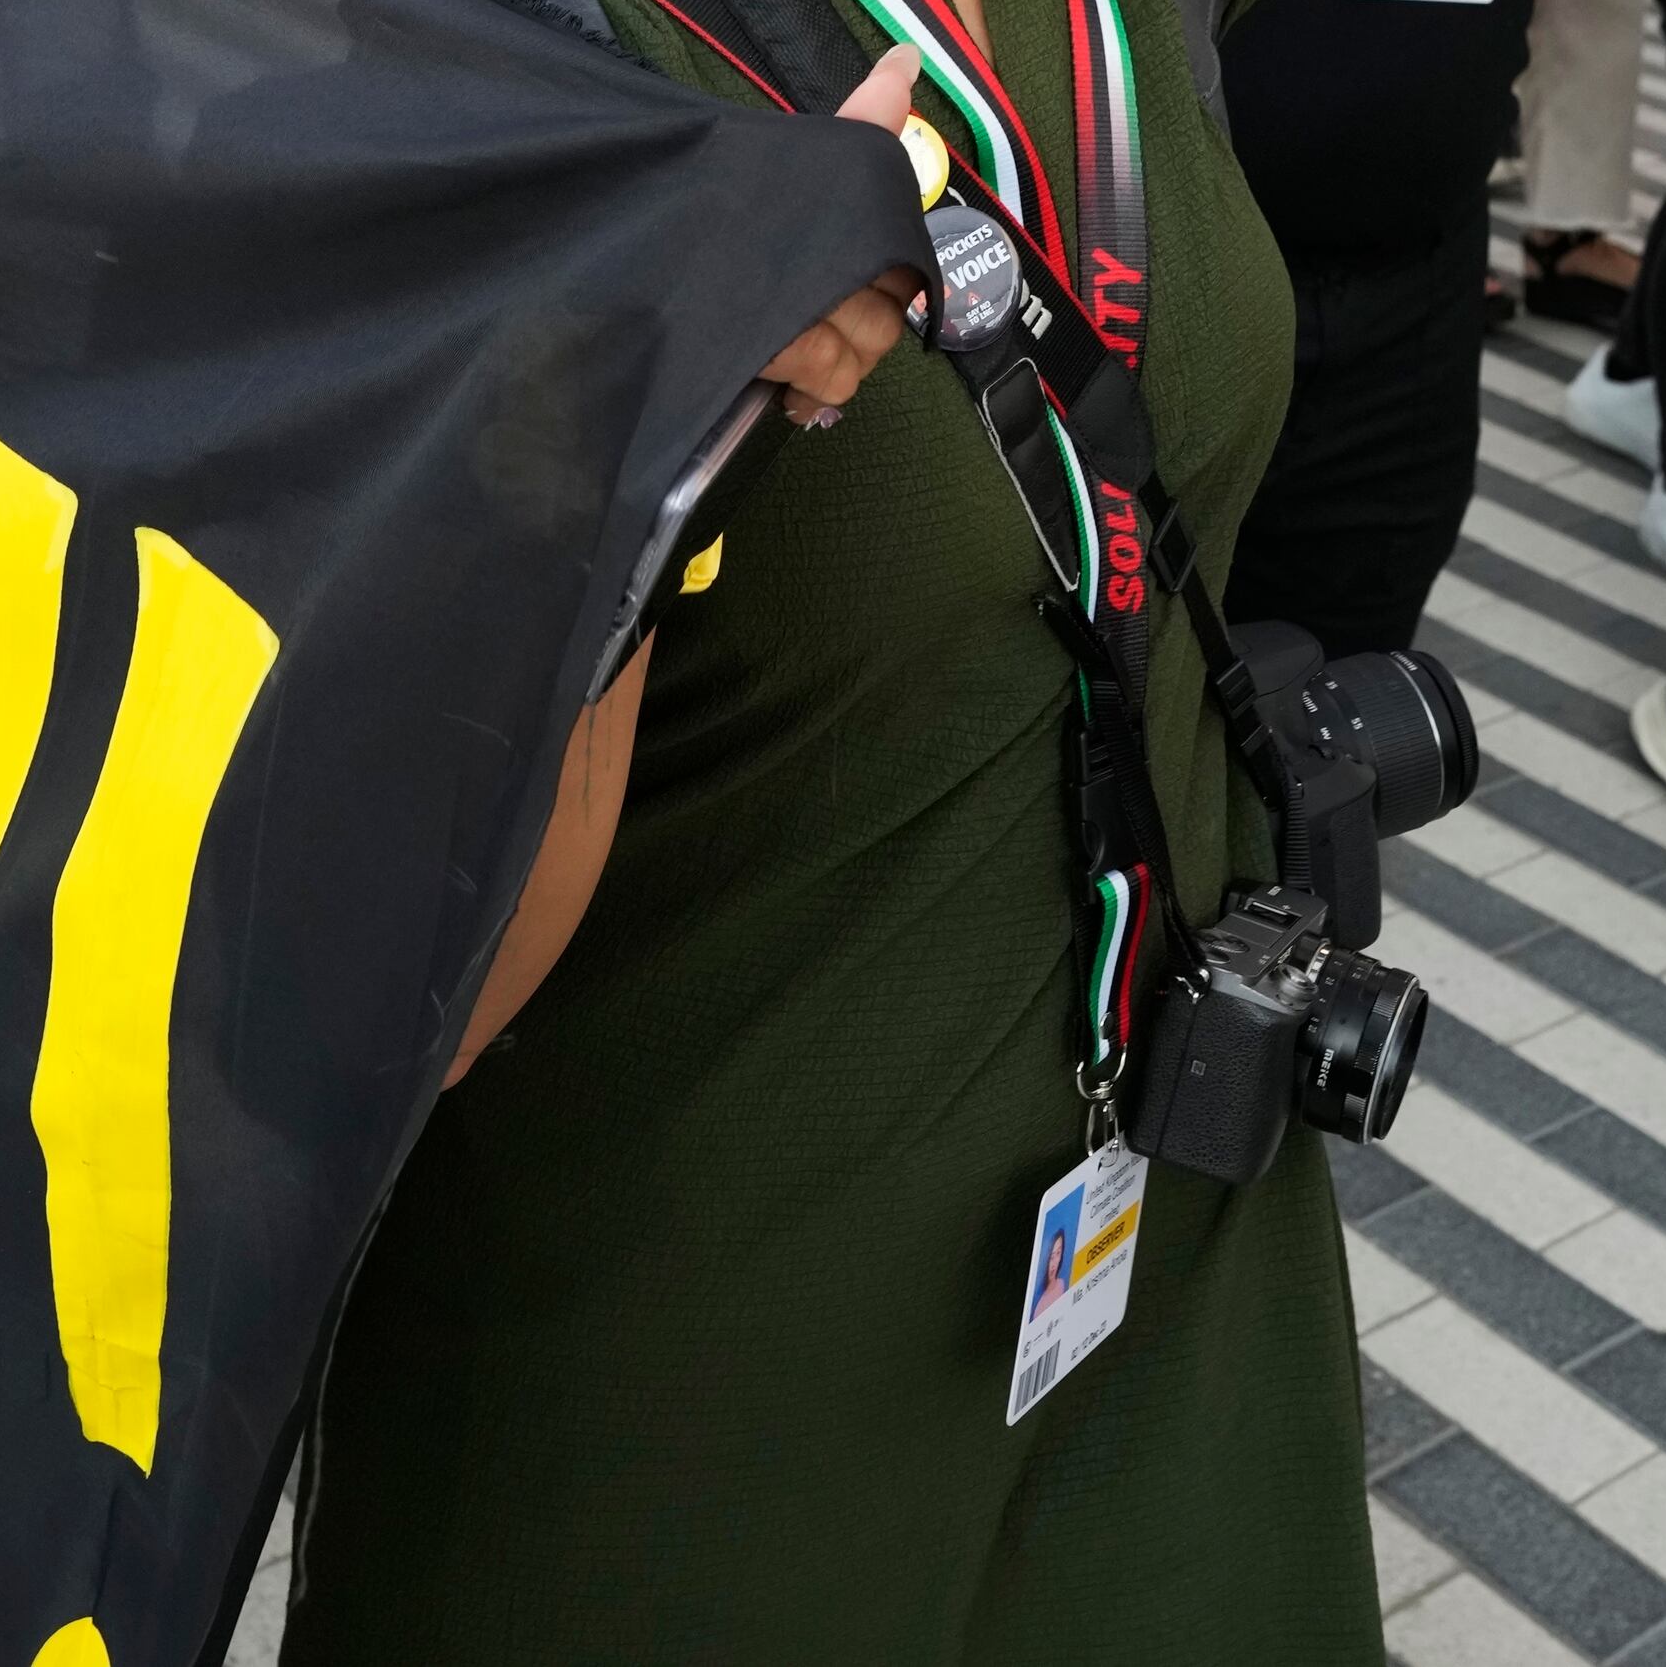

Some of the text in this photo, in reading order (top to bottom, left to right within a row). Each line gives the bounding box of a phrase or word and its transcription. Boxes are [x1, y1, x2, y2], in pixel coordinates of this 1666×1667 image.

[936, 223, 993, 267] POCKETS
[947, 240, 1012, 290] VOICE
[965, 300, 992, 320] SAY NO
[968, 307, 995, 326] TO LNG
[1086, 1220, 1126, 1265] OBSERVER
